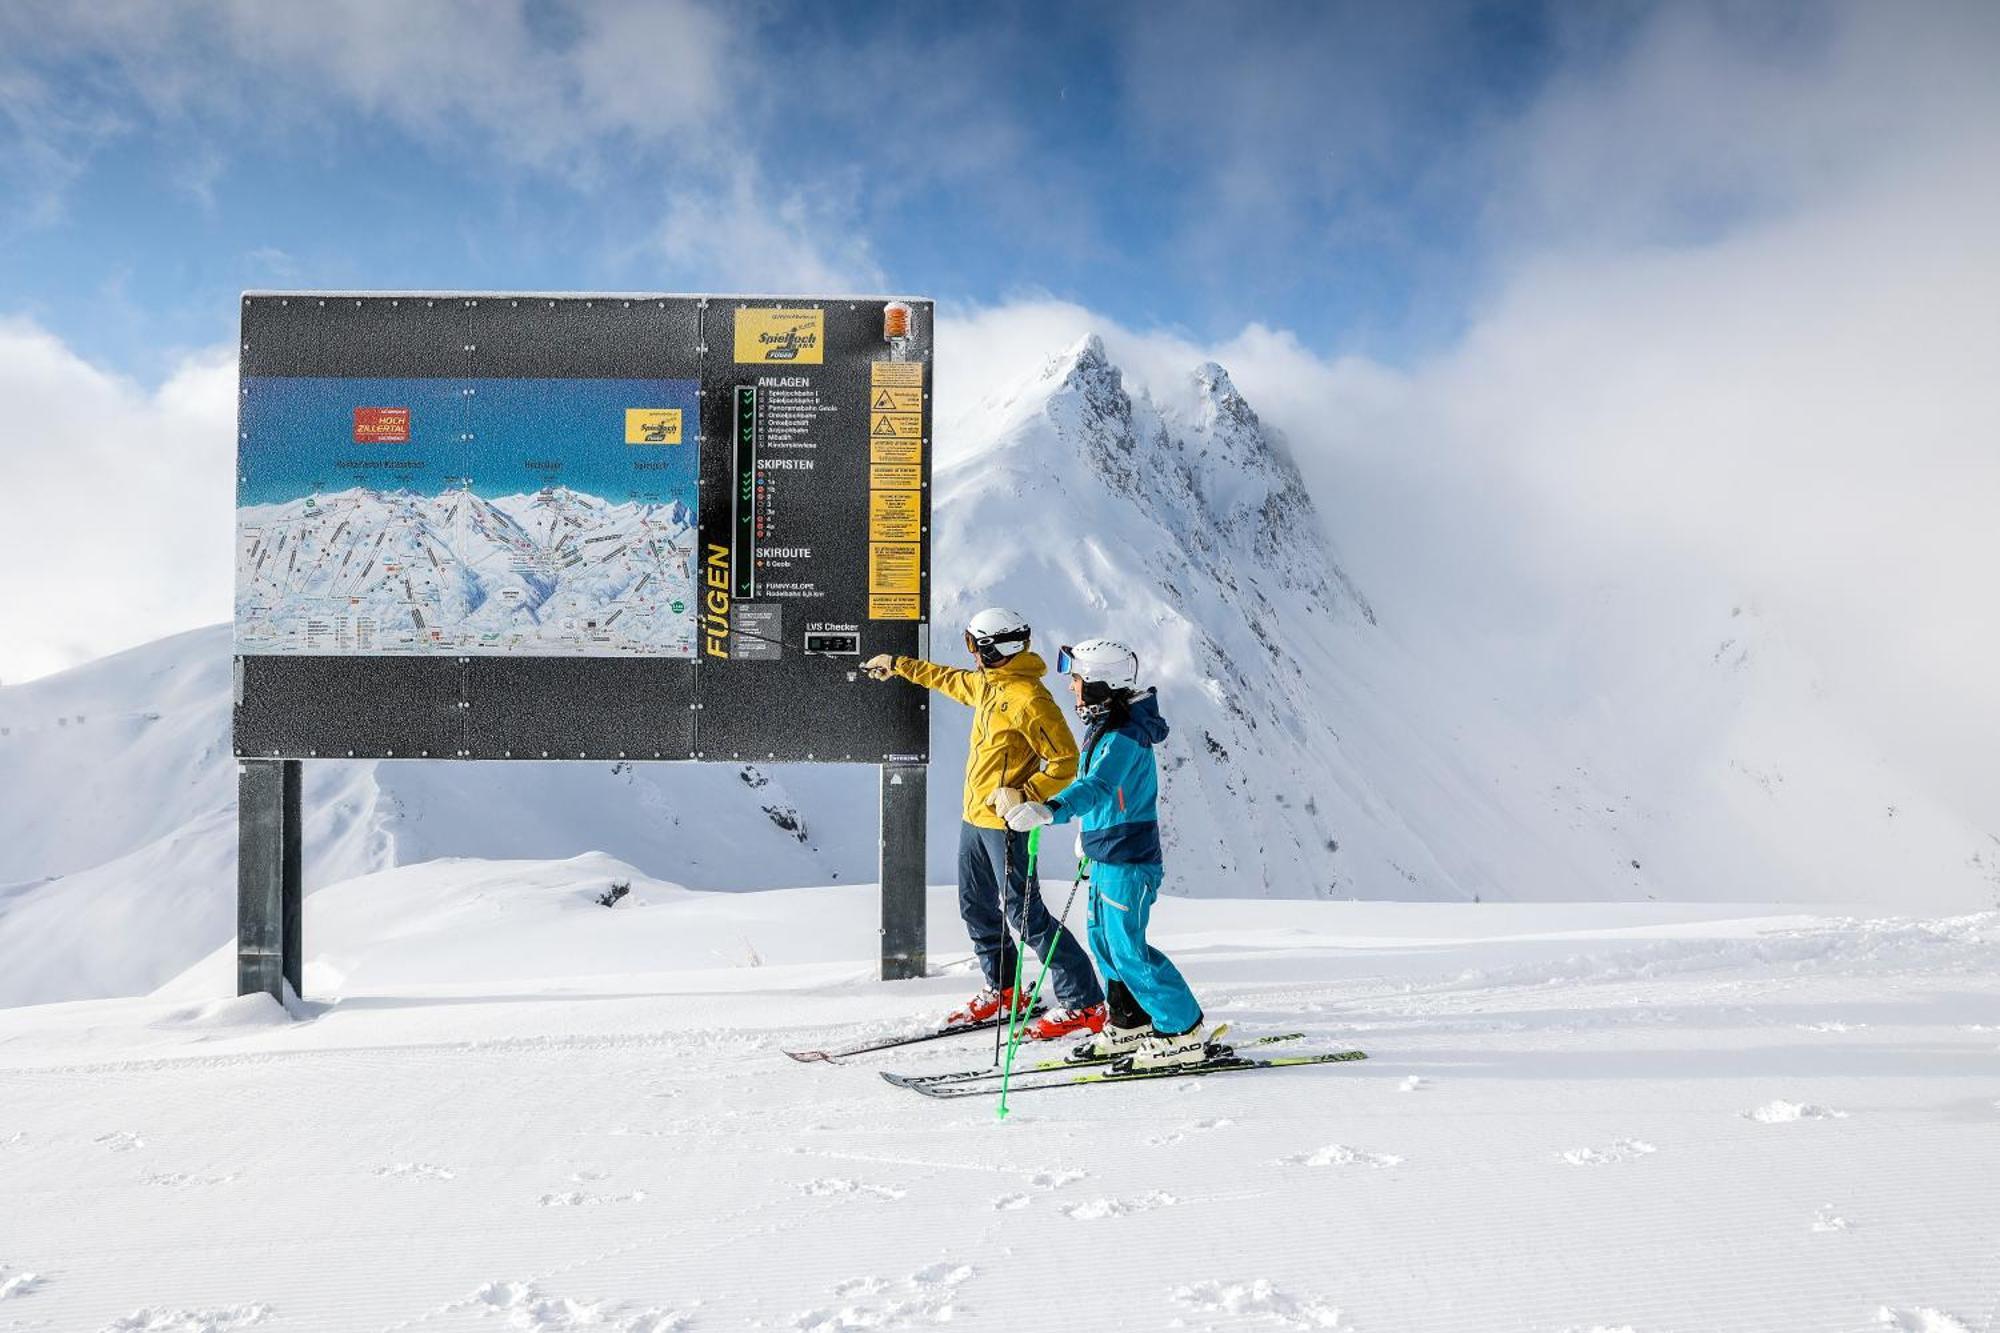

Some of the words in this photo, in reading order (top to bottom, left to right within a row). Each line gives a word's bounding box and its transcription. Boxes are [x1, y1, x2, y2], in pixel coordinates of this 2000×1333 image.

[758, 377, 810, 388] ANLAGEN
[379, 416, 405, 425] HOCH
[357, 424, 406, 433] ZILLERTAL
[757, 459, 814, 470] SKIPISTEN
[756, 548, 812, 558] SKIROUTE
[703, 543, 729, 659] FÜGEN
[806, 623, 823, 631] LVS
[824, 622, 859, 631] Checker
[1153, 1043, 1202, 1059] HEAD
